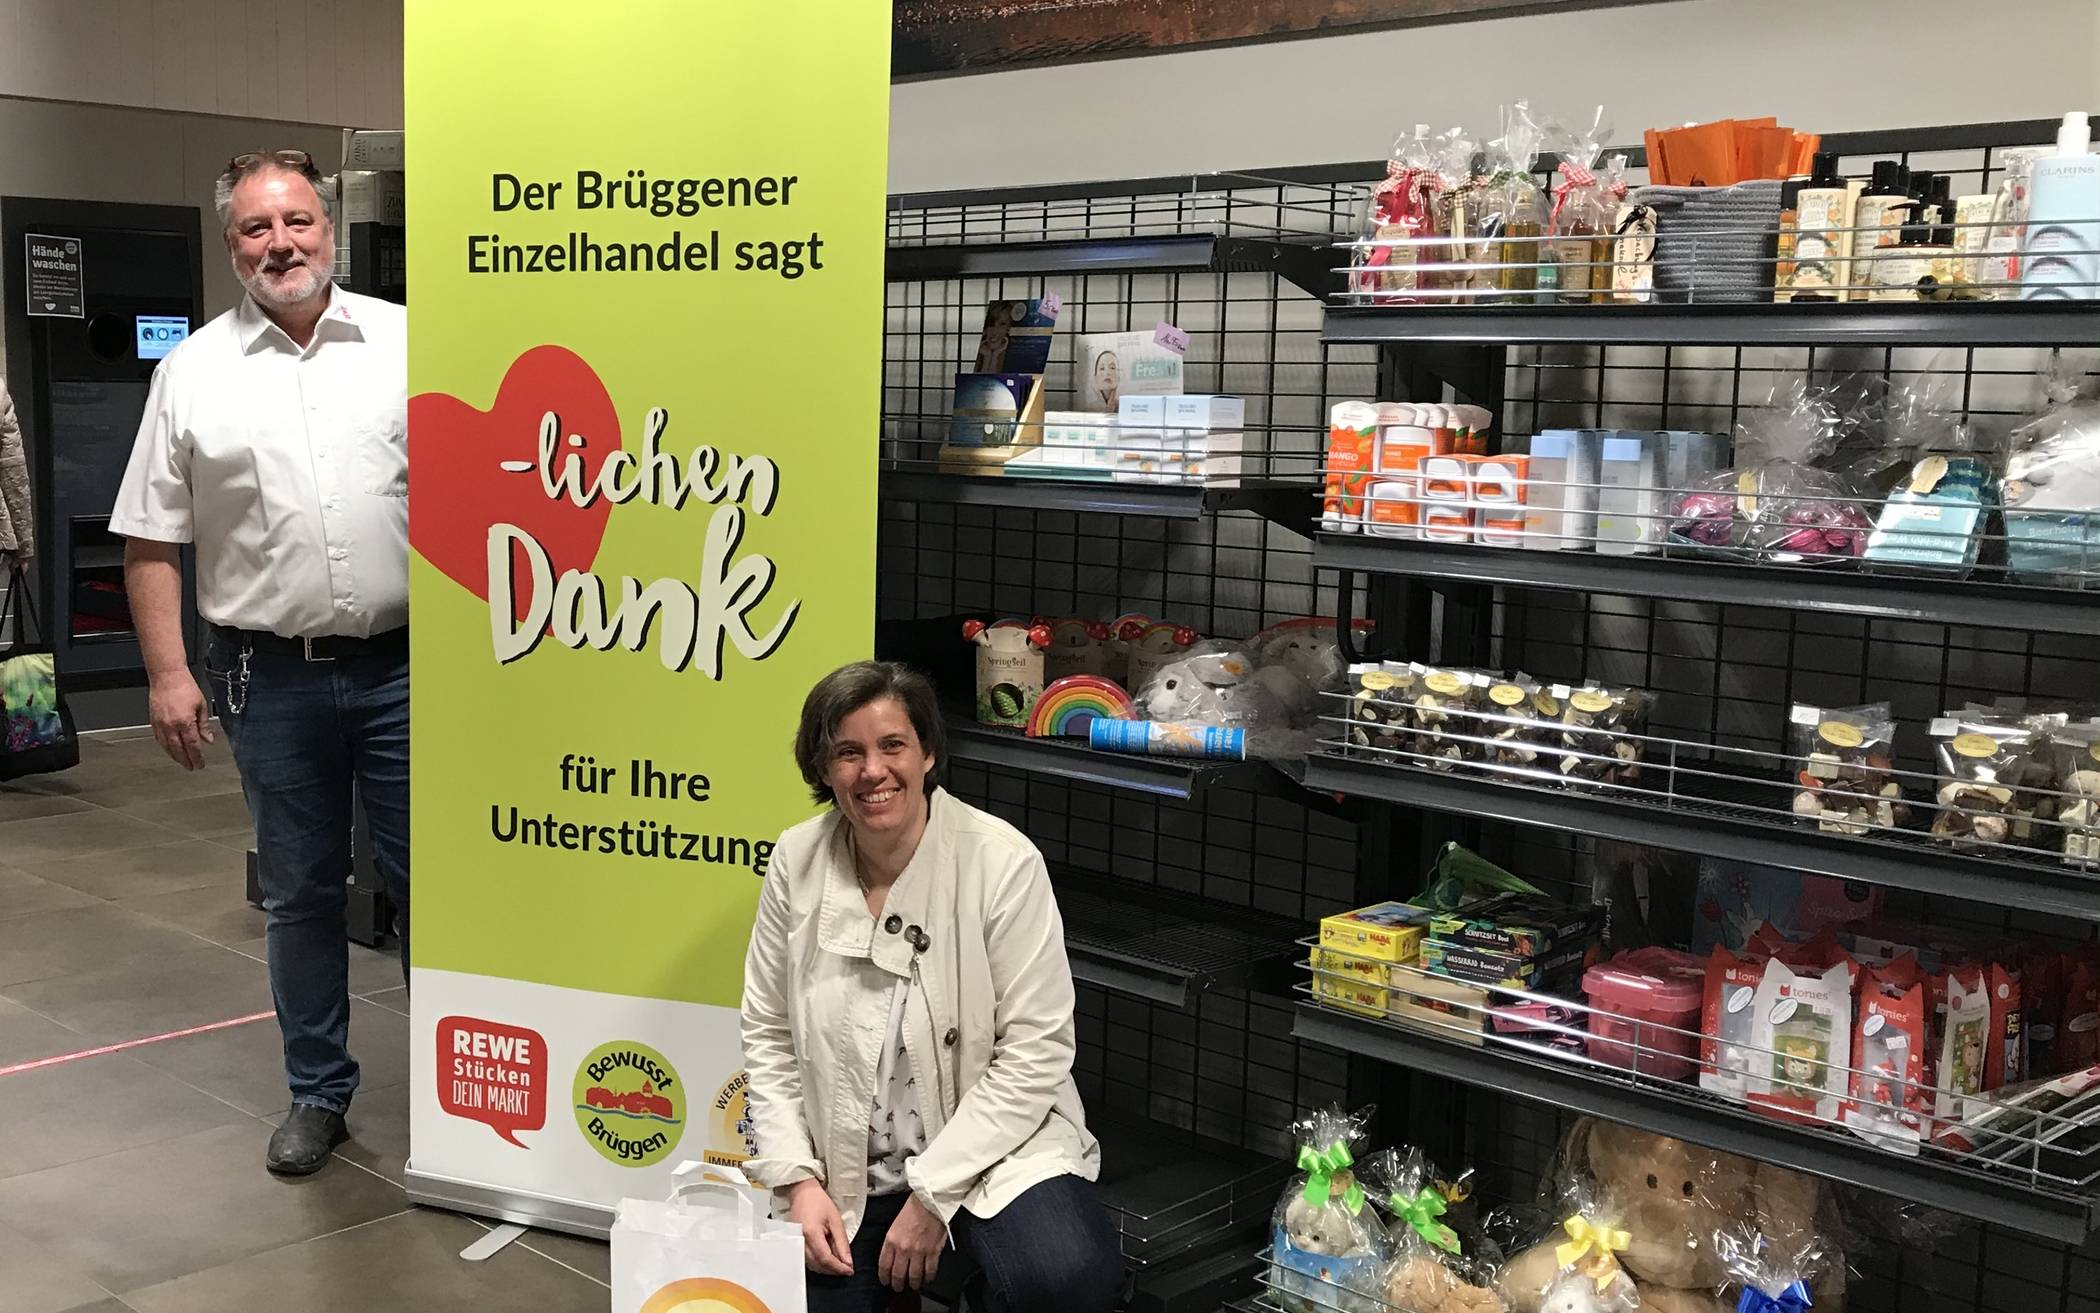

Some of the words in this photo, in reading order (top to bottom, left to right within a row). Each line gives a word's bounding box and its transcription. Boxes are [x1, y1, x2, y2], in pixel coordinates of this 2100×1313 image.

[2040, 165, 2095, 177] CLARINS
[492, 173, 562, 212] Der
[577, 170, 798, 217] Brüggener
[32, 245, 65, 258] Hände
[32, 259, 77, 271] waschen
[468, 231, 719, 273] Einzelhandel
[735, 232, 824, 279] sagt
[500, 406, 780, 516] -lichen
[487, 504, 802, 682] Dank
[560, 755, 616, 794] für
[630, 760, 711, 802] Ihre
[490, 805, 774, 875] Unterstützung
[1369, 933, 1392, 946] HABA
[453, 1029, 531, 1065] REWE
[453, 1058, 530, 1086] Stücken
[586, 1051, 673, 1091] Bewusst
[453, 1079, 482, 1108] DEIN
[487, 1085, 530, 1116] MARKT
[587, 1117, 668, 1160] Brüggen
